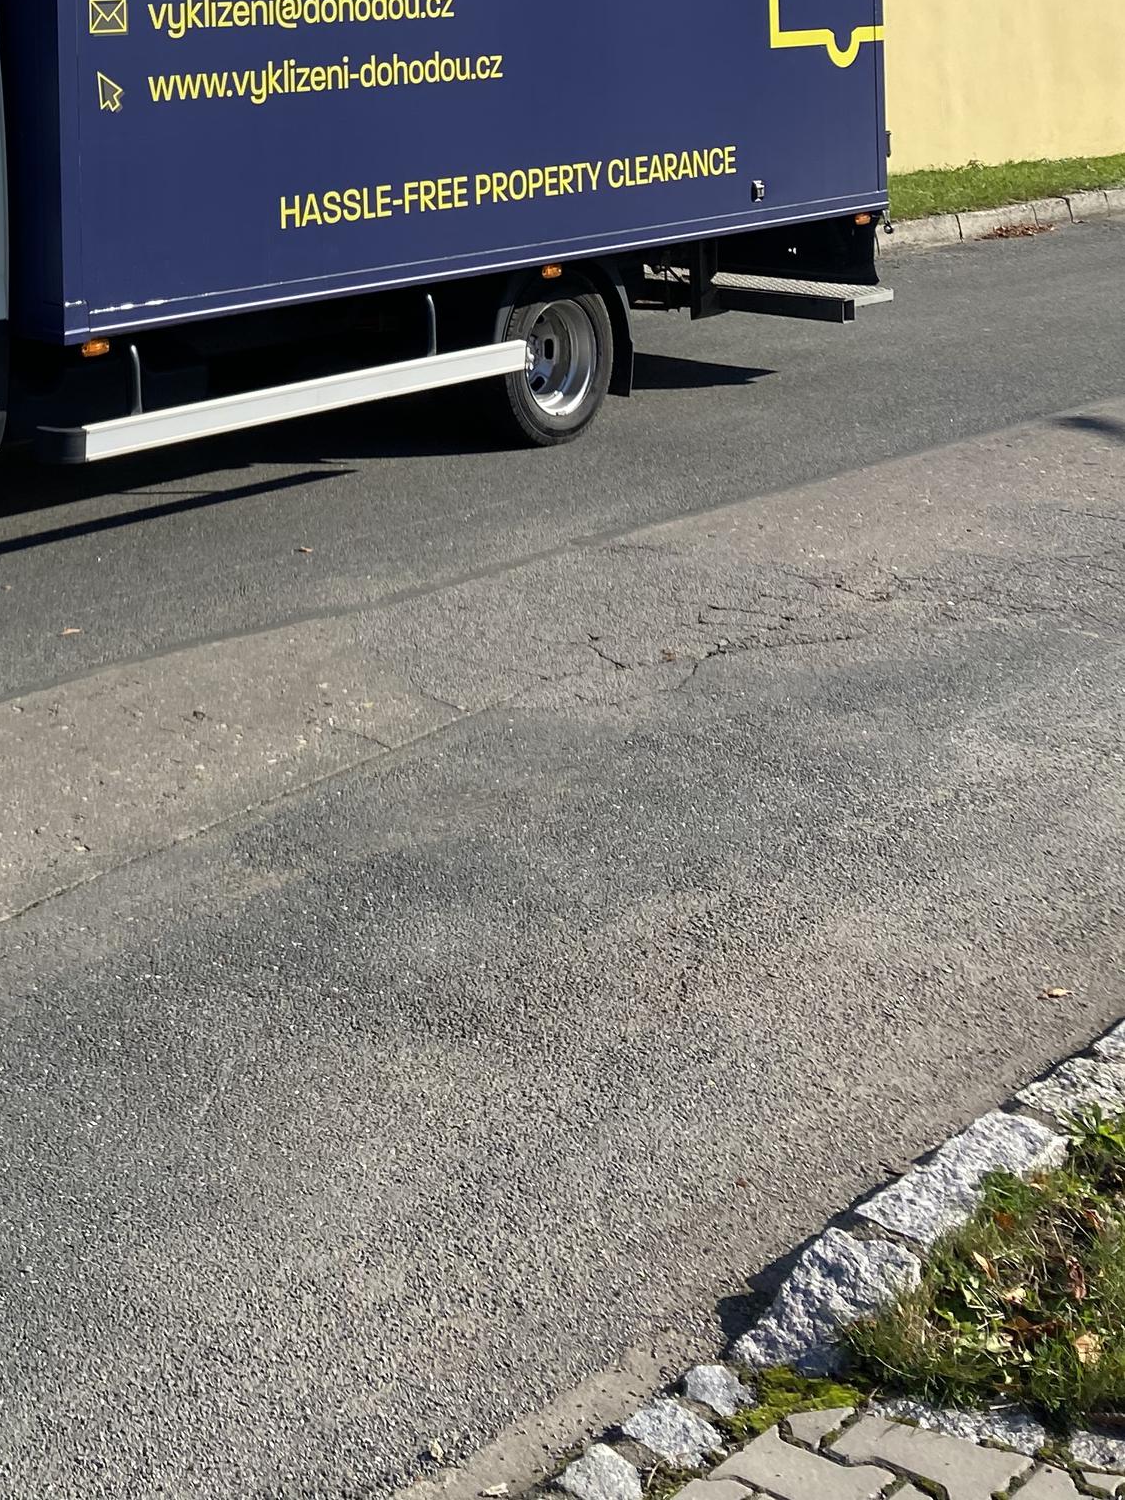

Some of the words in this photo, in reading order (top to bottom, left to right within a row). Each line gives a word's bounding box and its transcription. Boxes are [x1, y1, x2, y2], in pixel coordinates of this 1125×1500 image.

[147, 51, 503, 104] www.vyklizeni-dohodou.cz
[280, 175, 468, 229] HASSLE-FREE
[475, 161, 602, 206] PROPERTY
[607, 146, 737, 189] CLEARANCE
